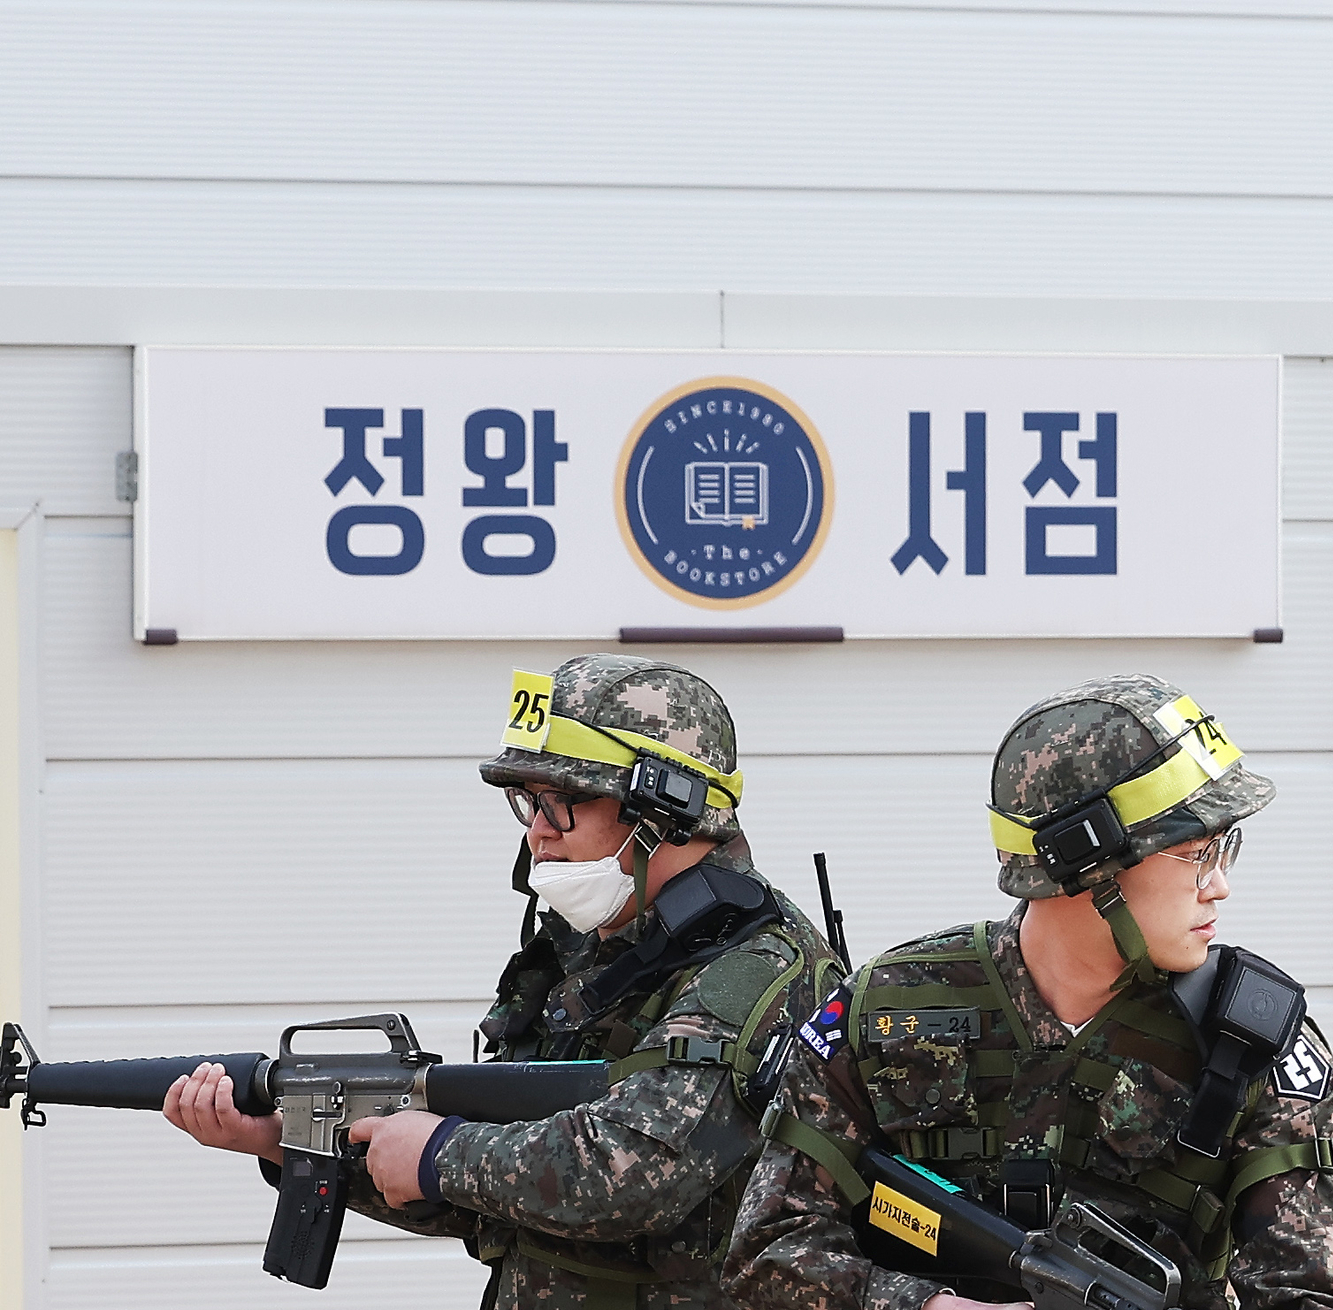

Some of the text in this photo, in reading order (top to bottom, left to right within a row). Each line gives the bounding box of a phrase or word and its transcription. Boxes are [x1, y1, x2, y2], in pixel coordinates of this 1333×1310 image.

[323, 407, 1118, 577] 정왕 서점
[664, 550, 788, 586] BOOKSTORE
[703, 544, 751, 561] The
[509, 690, 549, 733] 25
[872, 1196, 937, 1241] 시가지전술-24
